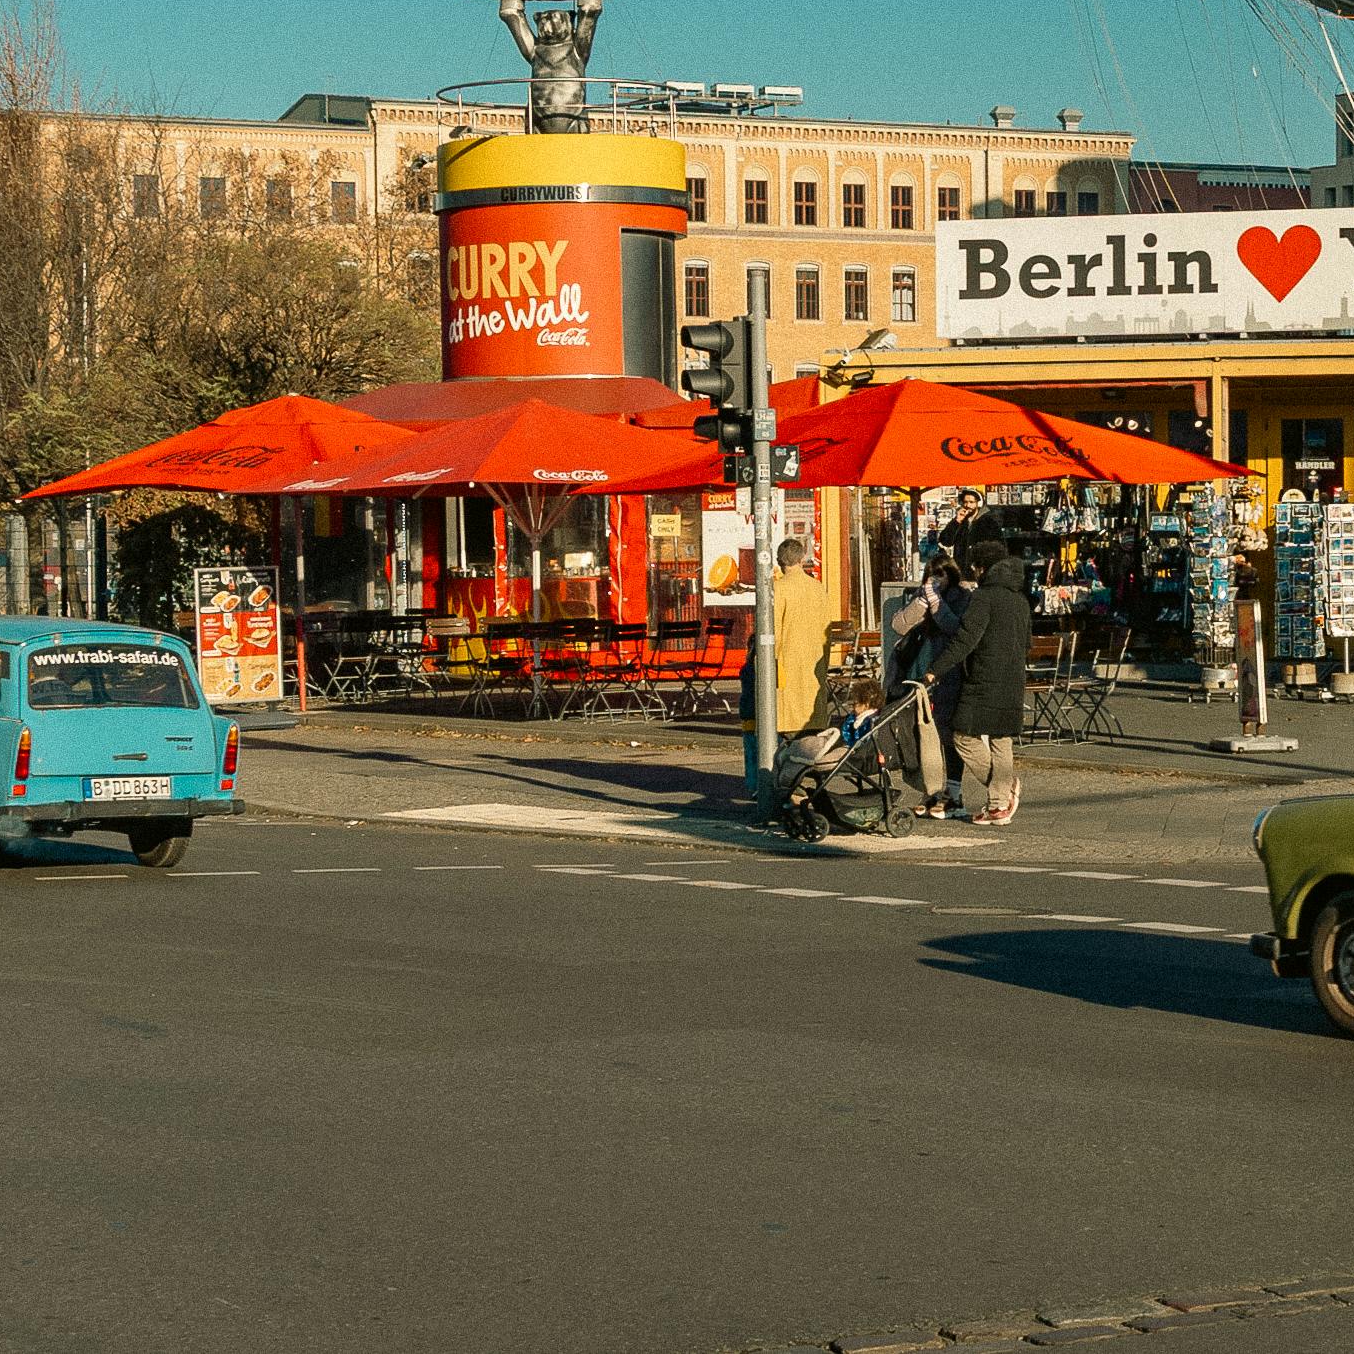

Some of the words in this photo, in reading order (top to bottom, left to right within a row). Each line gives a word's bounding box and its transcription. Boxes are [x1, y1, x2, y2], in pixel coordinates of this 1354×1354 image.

[447, 239, 570, 301] CURRY
[958, 232, 1219, 300] Berlin
[449, 307, 465, 344] at
[466, 304, 506, 339] the
[504, 282, 591, 332] Wall
[33, 649, 180, 667] www.trabi-safari.de
